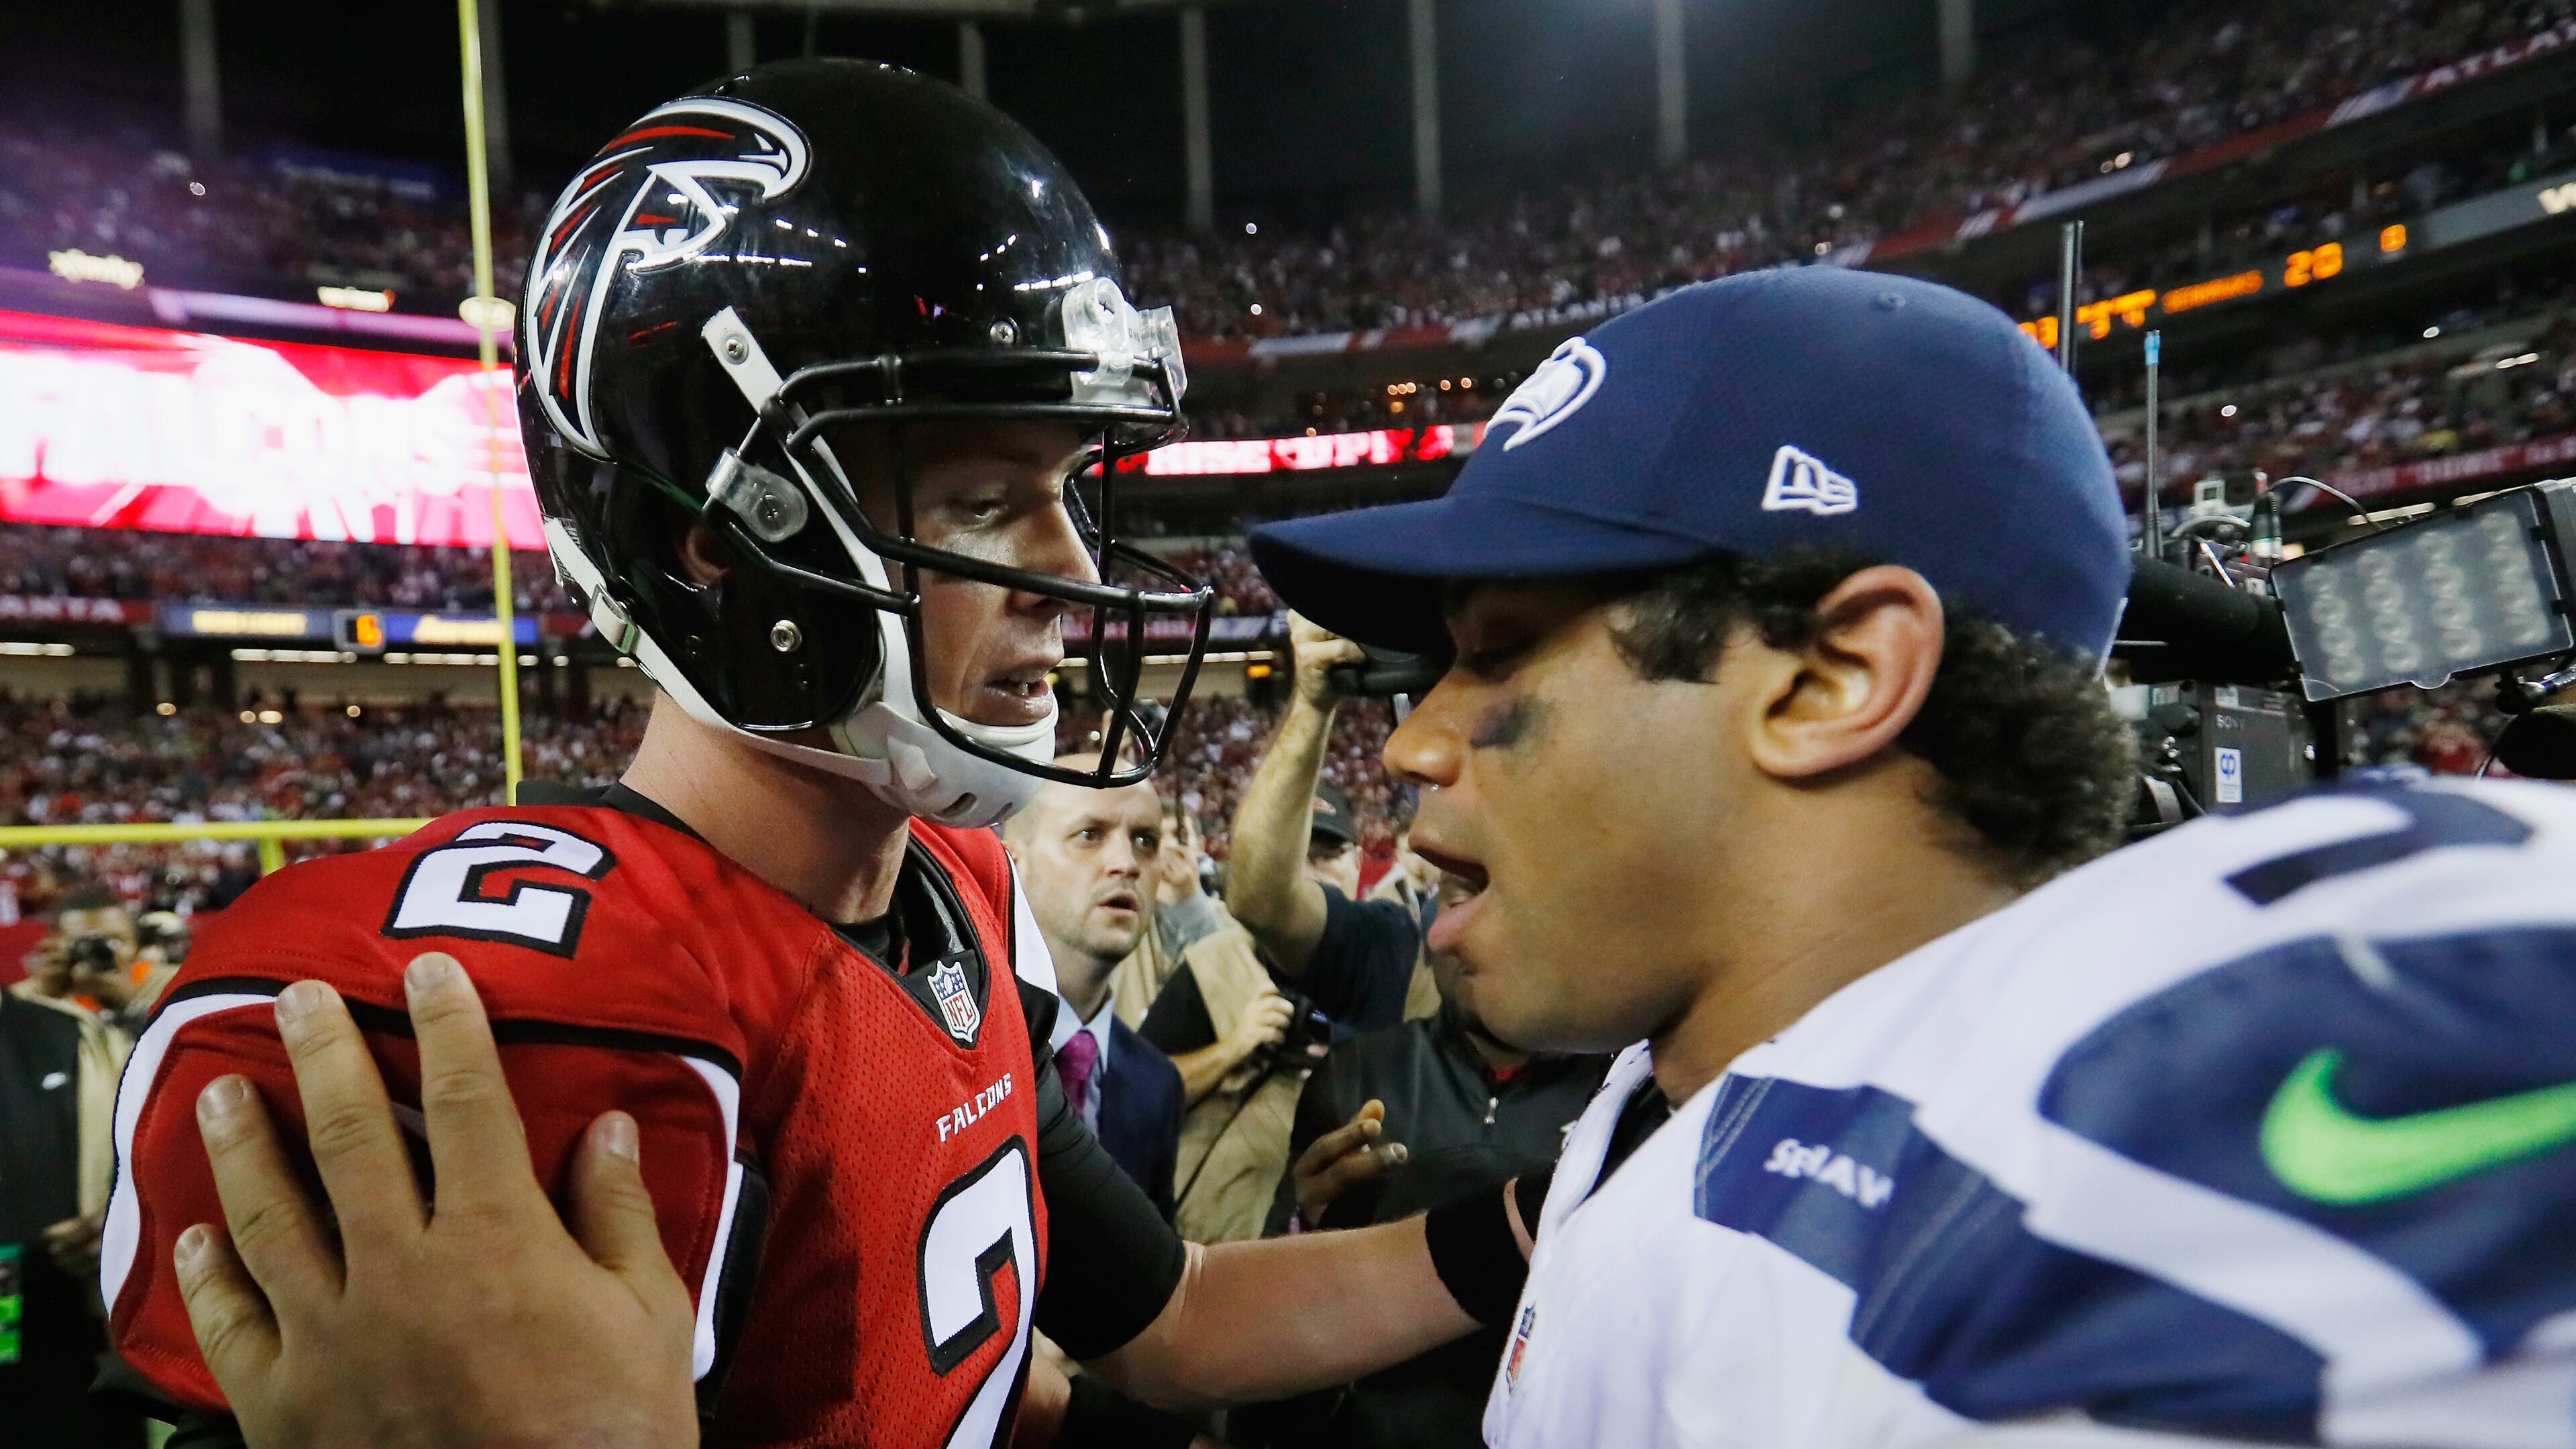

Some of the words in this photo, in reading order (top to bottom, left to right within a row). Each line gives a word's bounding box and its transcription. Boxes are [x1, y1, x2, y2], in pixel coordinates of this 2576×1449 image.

[1146, 440, 1271, 475] RISE
[1288, 431, 1389, 469] UP!
[386, 821, 610, 951] 2
[945, 994, 974, 1028] NFL
[936, 1073, 1013, 1143] FALCONS
